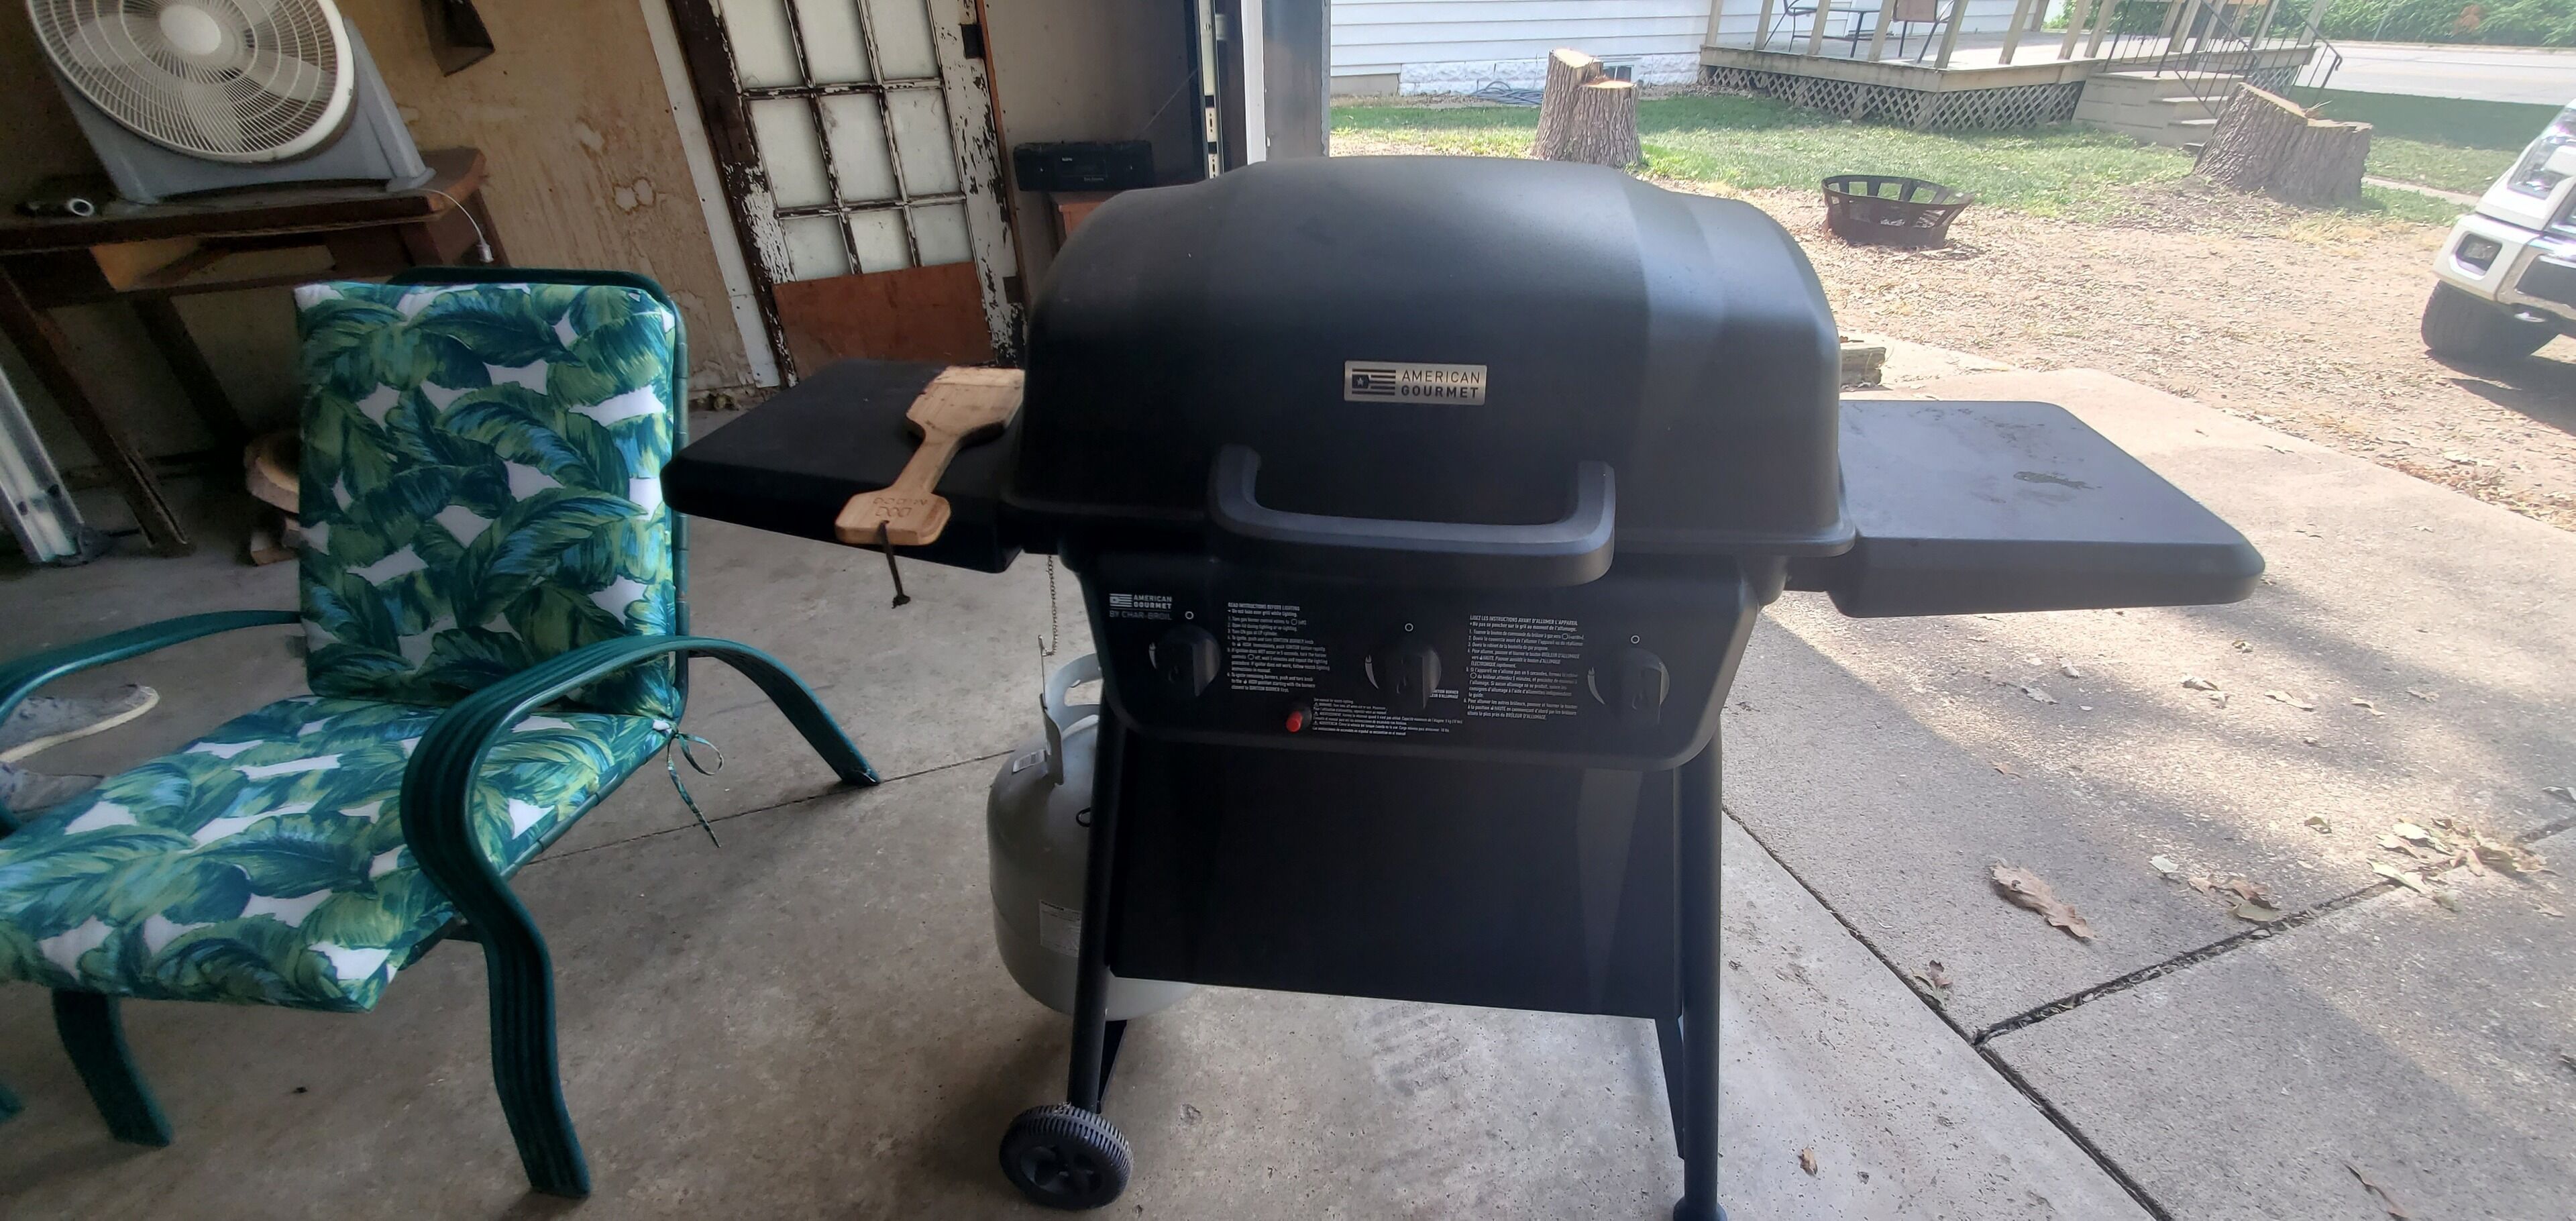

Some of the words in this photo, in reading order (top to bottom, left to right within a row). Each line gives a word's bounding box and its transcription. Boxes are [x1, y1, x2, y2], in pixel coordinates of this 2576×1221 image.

[1402, 370, 1480, 383] AMERICAN
[1401, 386, 1479, 398] GOURMET
[1134, 594, 1173, 602] AMERICAN
[1134, 601, 1173, 609] GOURMET
[1121, 610, 1173, 621] CHAR-BROIL
